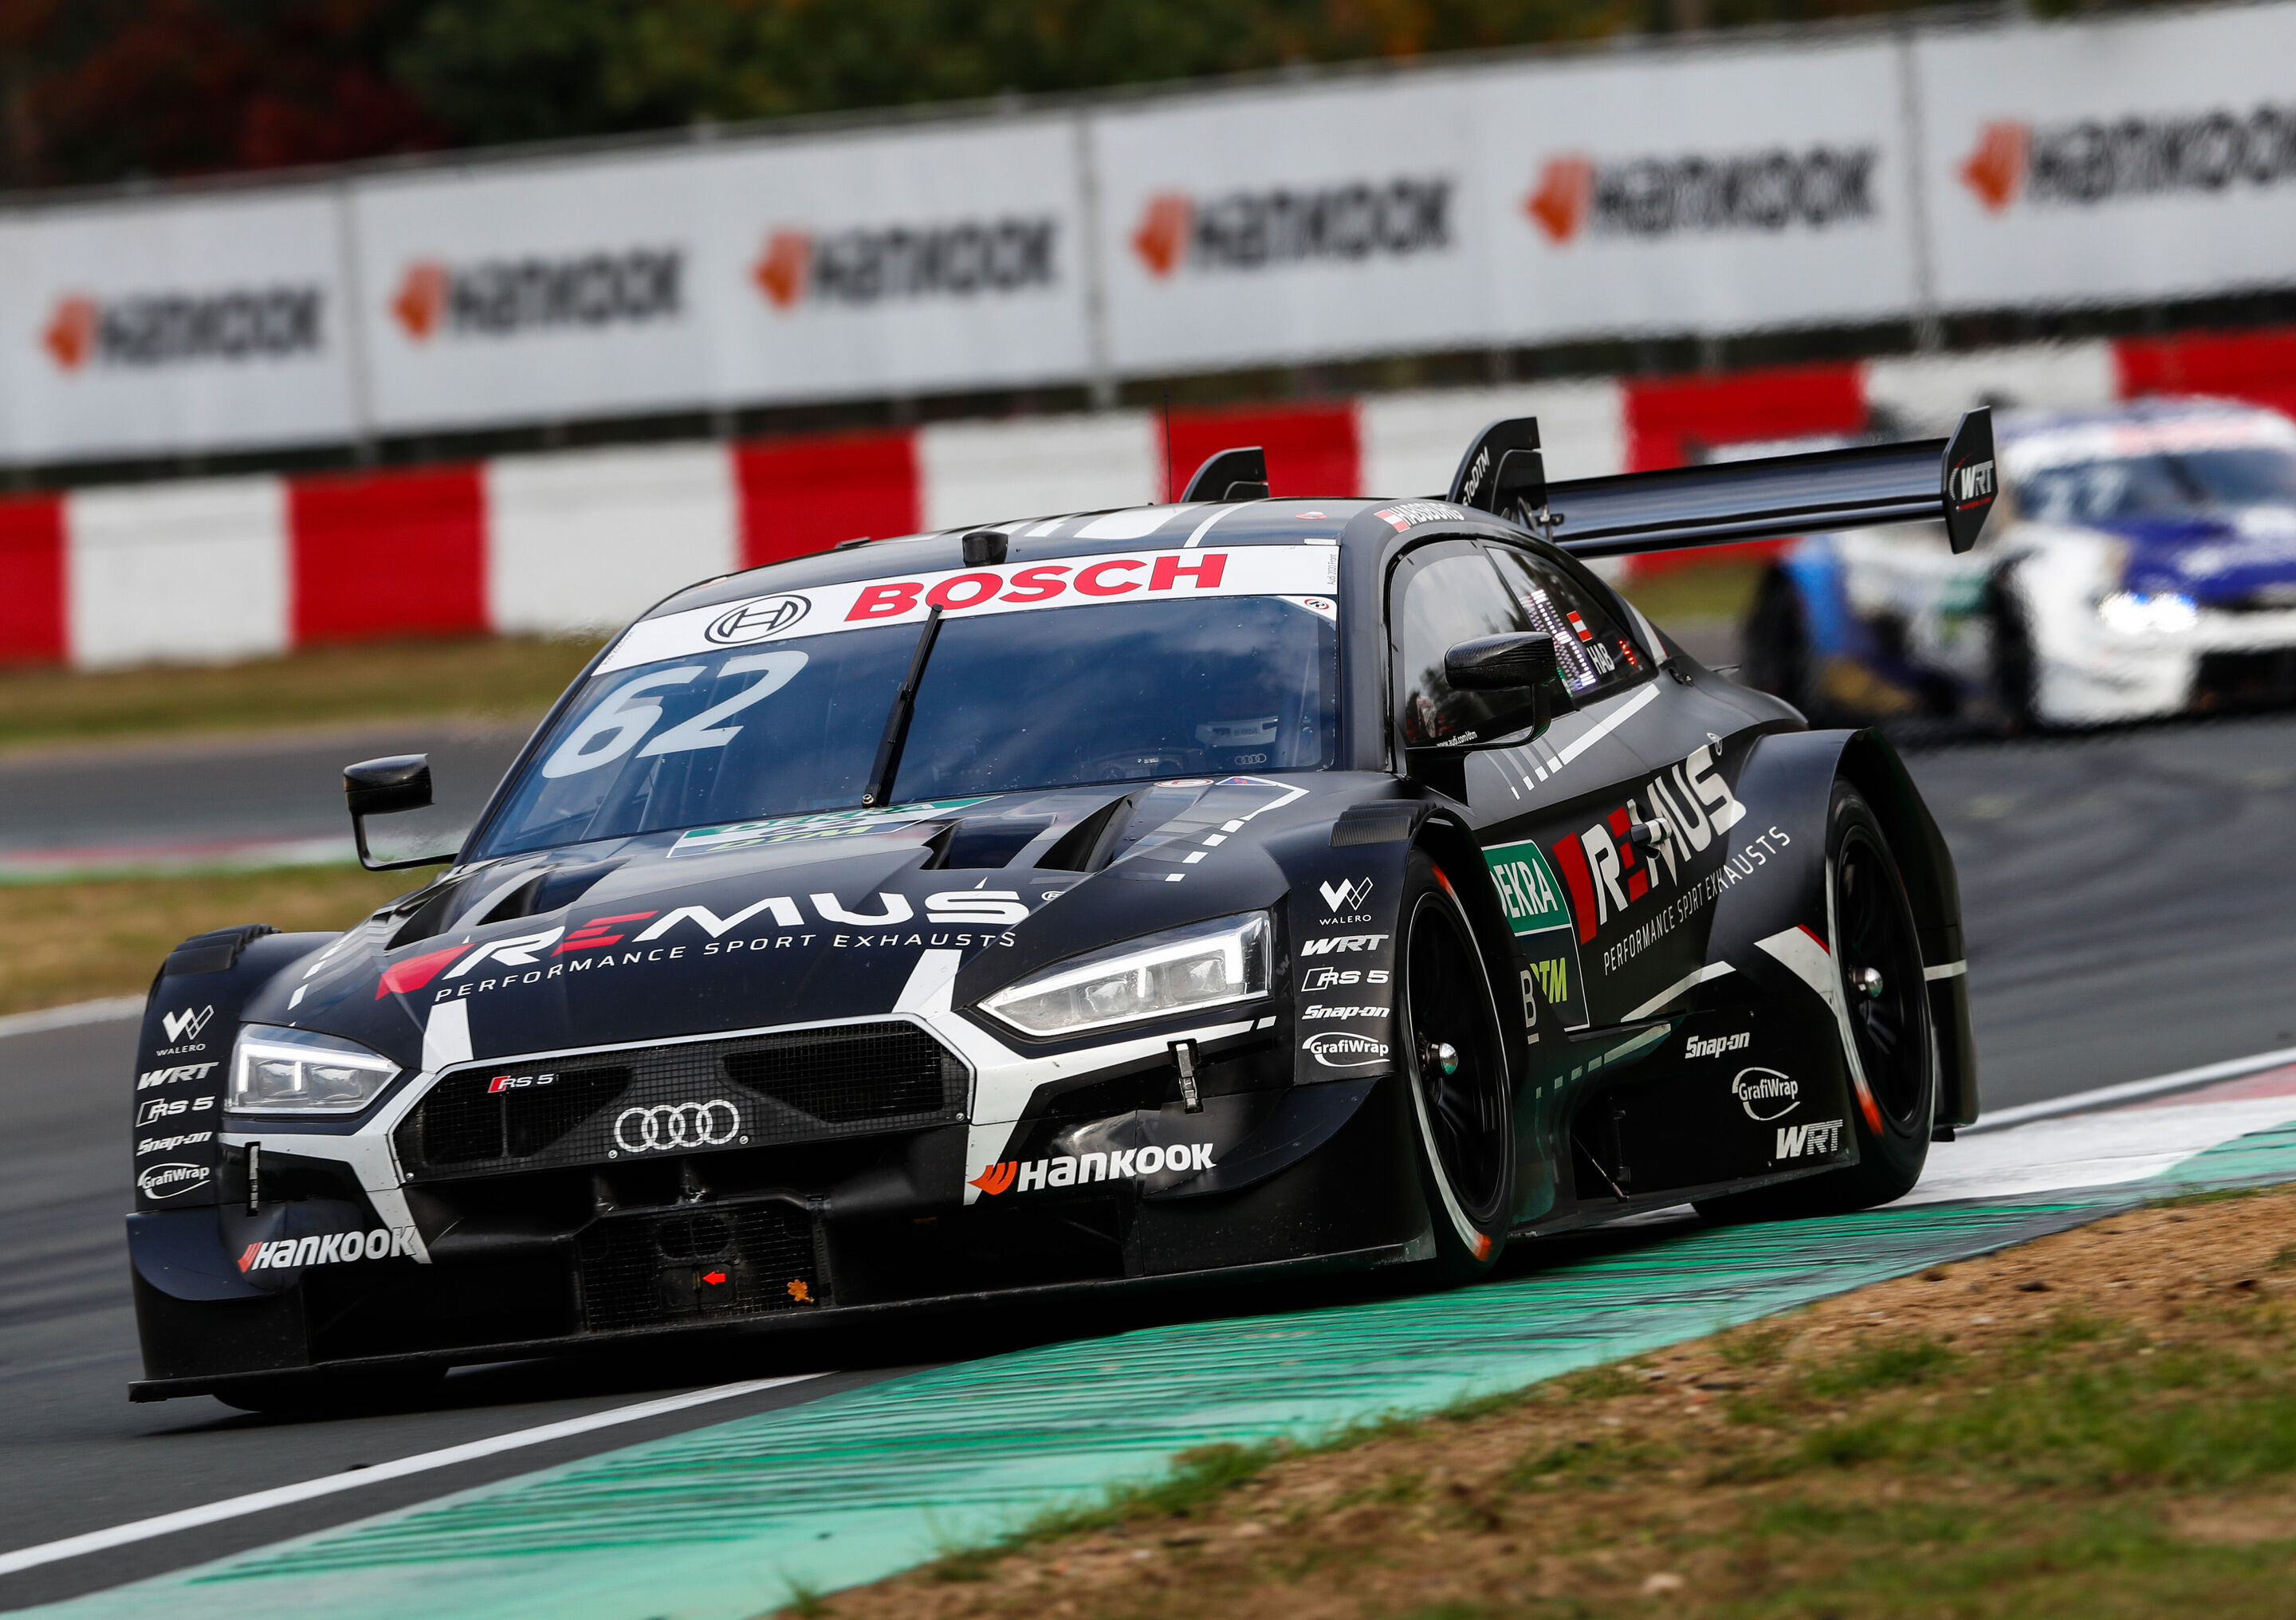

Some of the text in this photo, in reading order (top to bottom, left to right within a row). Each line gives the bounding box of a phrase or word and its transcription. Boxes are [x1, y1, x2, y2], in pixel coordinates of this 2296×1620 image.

[1961, 460, 1993, 500] WRT
[844, 553, 1228, 622] BOSCH
[1586, 643, 1615, 674] HAB
[542, 650, 809, 780] 62
[720, 804, 936, 833] DEKRA
[706, 825, 875, 852] DTM
[1581, 745, 1747, 926] REMUS
[1604, 905, 1675, 976] PERFORMANCE
[1705, 826, 1791, 901] EXHAUSTS
[1319, 914, 1372, 926] WALERO
[441, 890, 1030, 981] REMUS
[1301, 934, 1390, 957] WRT
[434, 931, 1017, 1002] PERFORMANCE SPORT EXHAUSTS
[1301, 1004, 1390, 1020] Snap-on
[156, 1043, 206, 1056] WALERO
[1311, 1040, 1390, 1057] GrafiWrap
[1685, 1032, 1750, 1059] Snap-on
[136, 1061, 219, 1091] WRT
[1738, 1075, 1799, 1102] GrafiWrap
[136, 1130, 213, 1156] Snap-on
[1775, 1119, 1843, 1160] WRT
[141, 1166, 210, 1190] GrafiWrap
